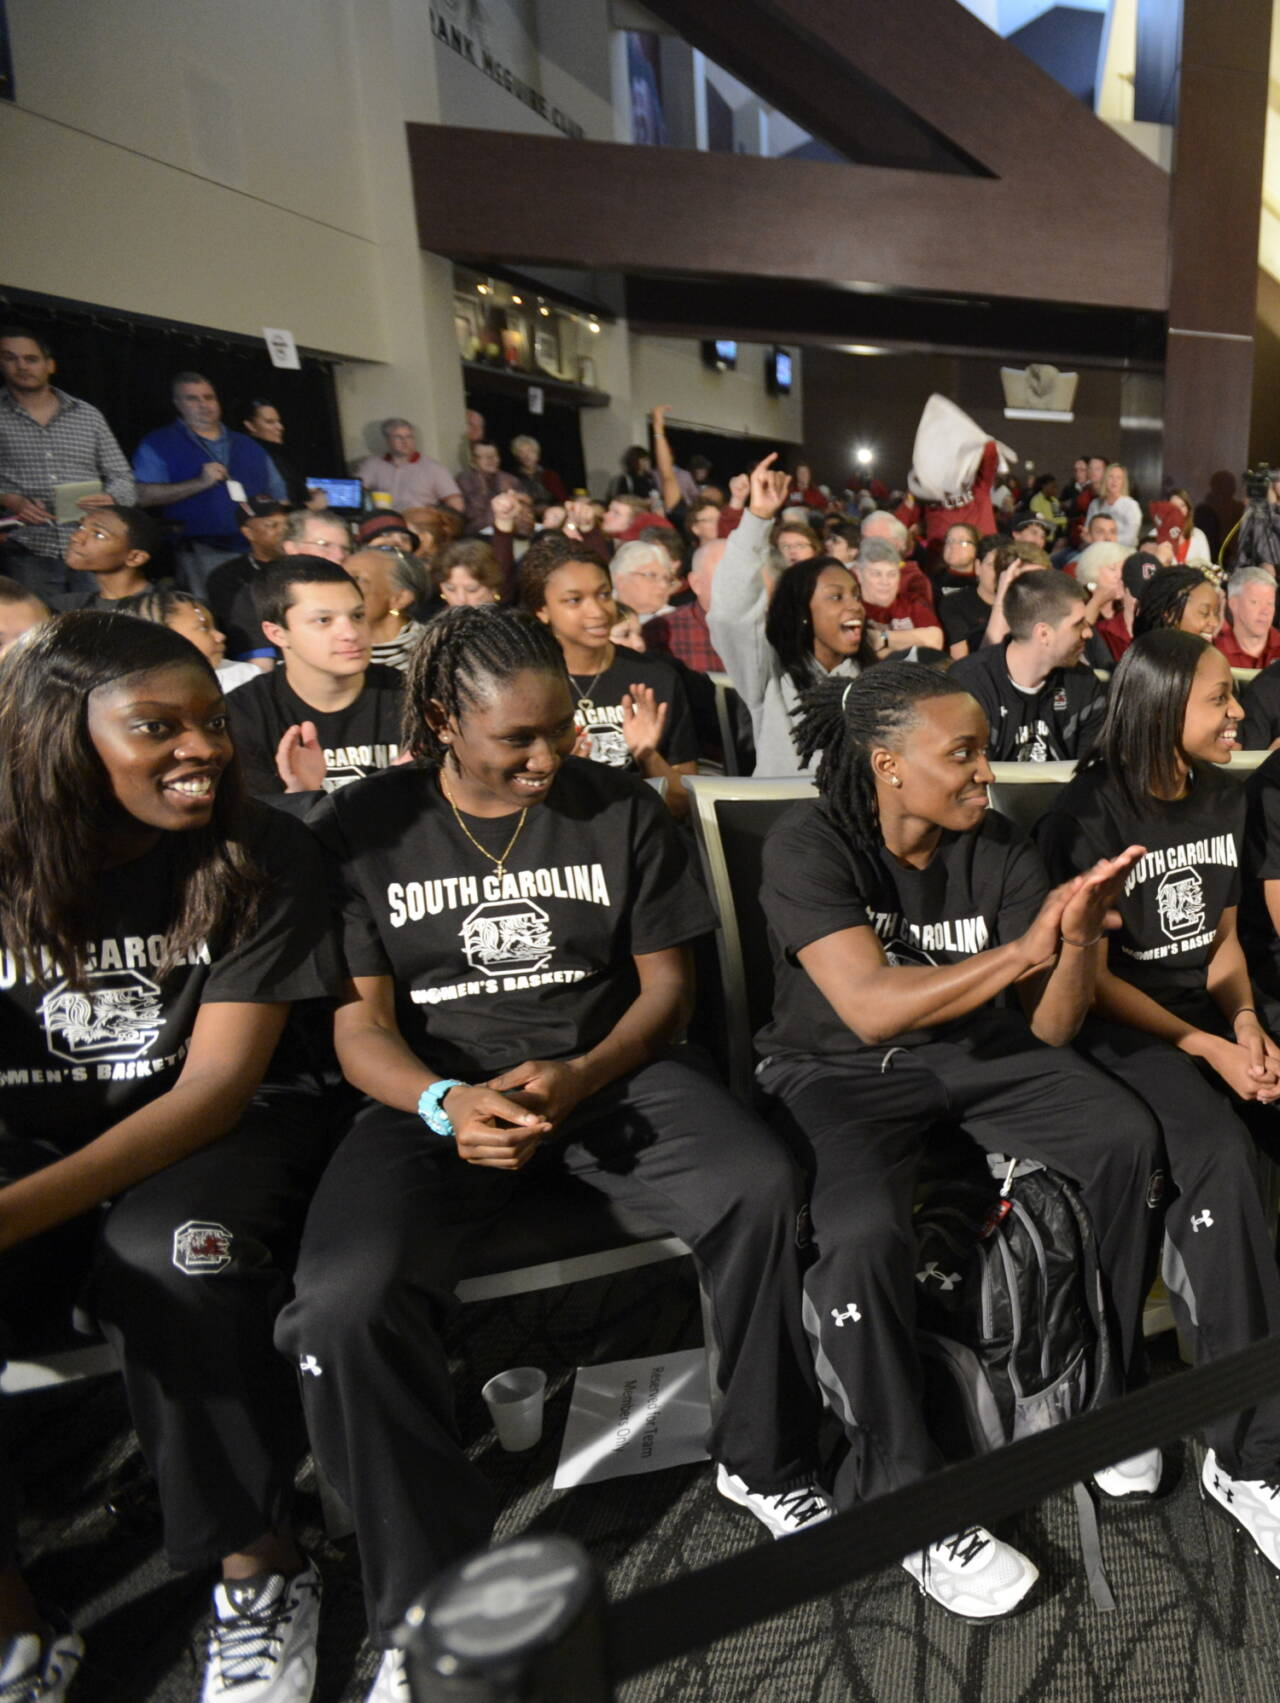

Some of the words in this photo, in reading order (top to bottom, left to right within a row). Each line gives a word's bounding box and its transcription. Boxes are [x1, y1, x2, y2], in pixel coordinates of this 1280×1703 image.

[1166, 832, 1238, 869] CAROLINA
[387, 875, 479, 929] SOUTH
[482, 863, 611, 907] CAROLINA
[410, 979, 499, 1004] WOMEN'S
[617, 1380, 638, 1427] Members
[647, 1366, 665, 1412] Reserved
[641, 1427, 658, 1458] Team
